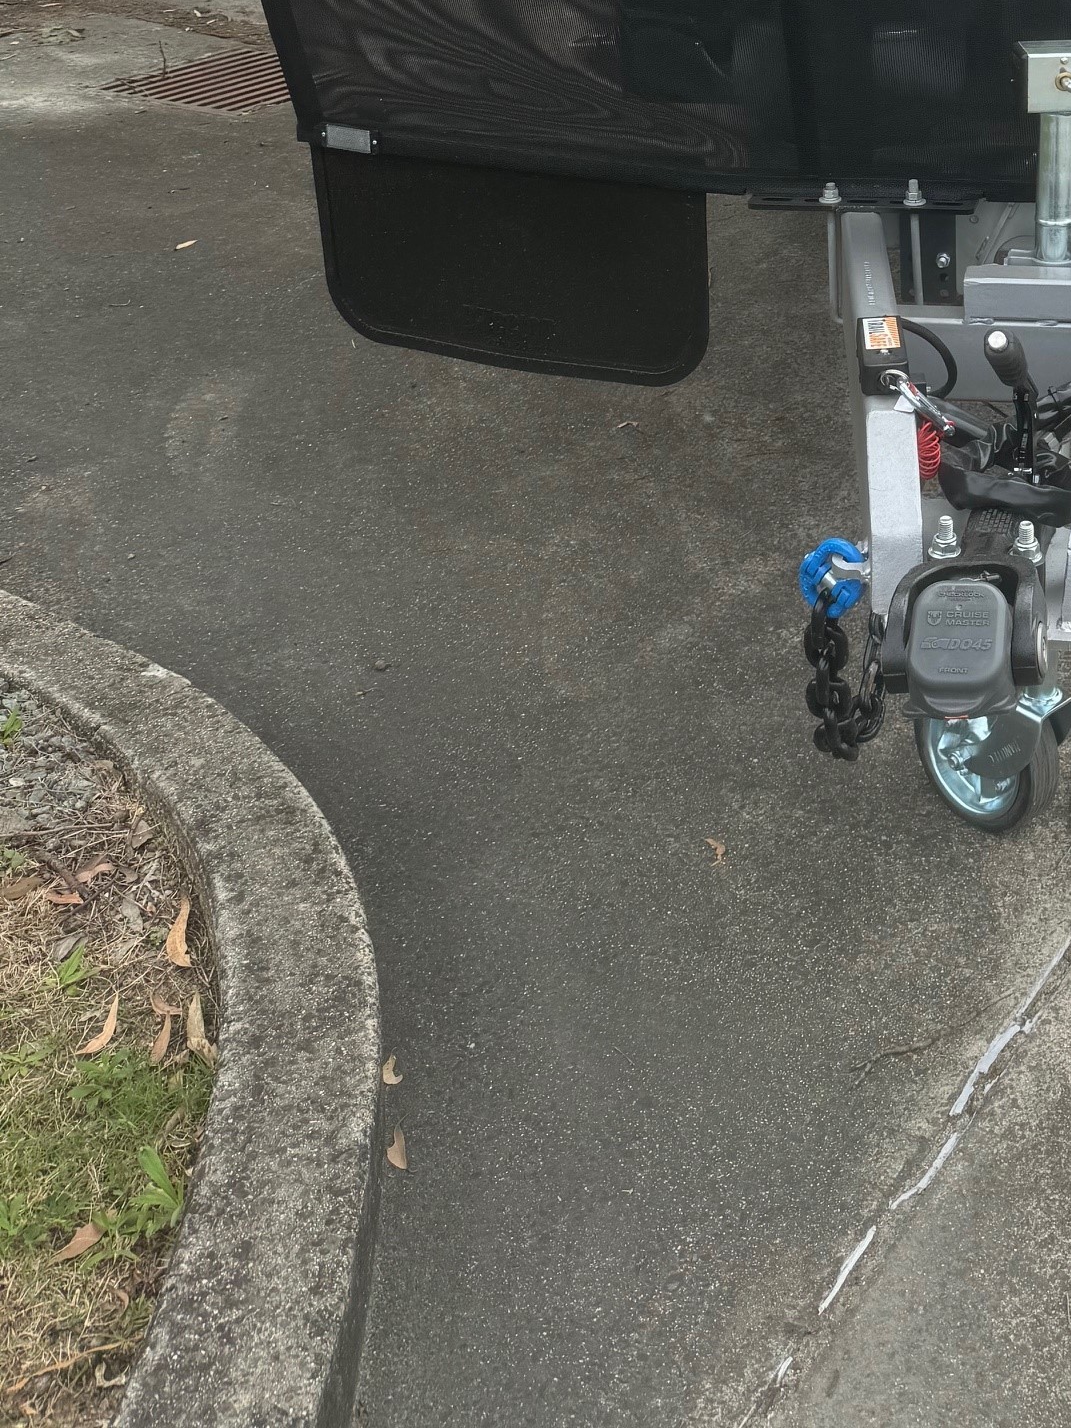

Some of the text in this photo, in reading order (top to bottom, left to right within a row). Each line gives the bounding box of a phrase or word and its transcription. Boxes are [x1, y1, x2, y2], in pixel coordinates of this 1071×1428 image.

[946, 610, 990, 619] CRUISE
[945, 618, 991, 627] MASTER
[938, 666, 969, 675] FRONT
